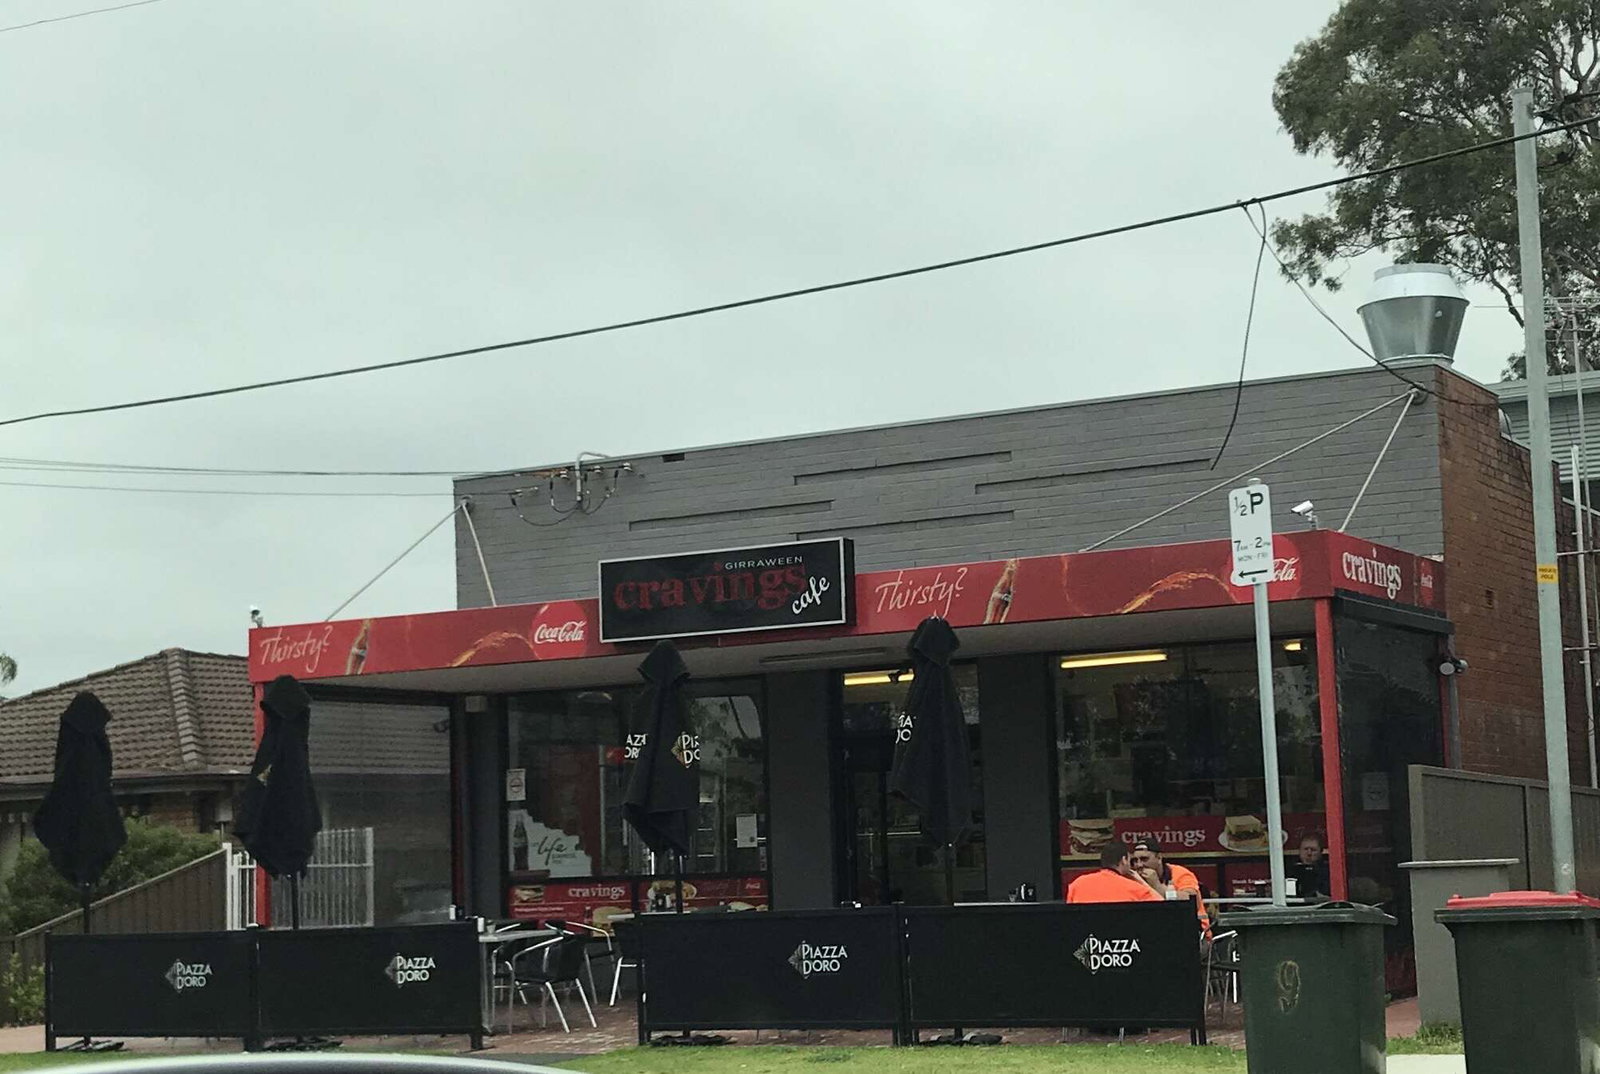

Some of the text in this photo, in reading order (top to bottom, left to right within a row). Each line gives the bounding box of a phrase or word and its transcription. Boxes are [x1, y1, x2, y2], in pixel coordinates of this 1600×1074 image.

[724, 555, 803, 570] GIRRAWEEN
[1273, 557, 1300, 582] ola
[1342, 547, 1402, 600] cravings
[613, 561, 808, 611] cravings
[791, 575, 831, 615] cafe
[874, 567, 968, 619] Thirsty?
[259, 624, 334, 674] Thirsty?
[1121, 825, 1206, 847] cravings
[568, 883, 626, 900] cravings
[802, 943, 848, 960] PIAZZA
[1089, 937, 1141, 954] PIAZZA
[176, 961, 213, 976] PIAZZA
[396, 955, 436, 970] PIAZZA
